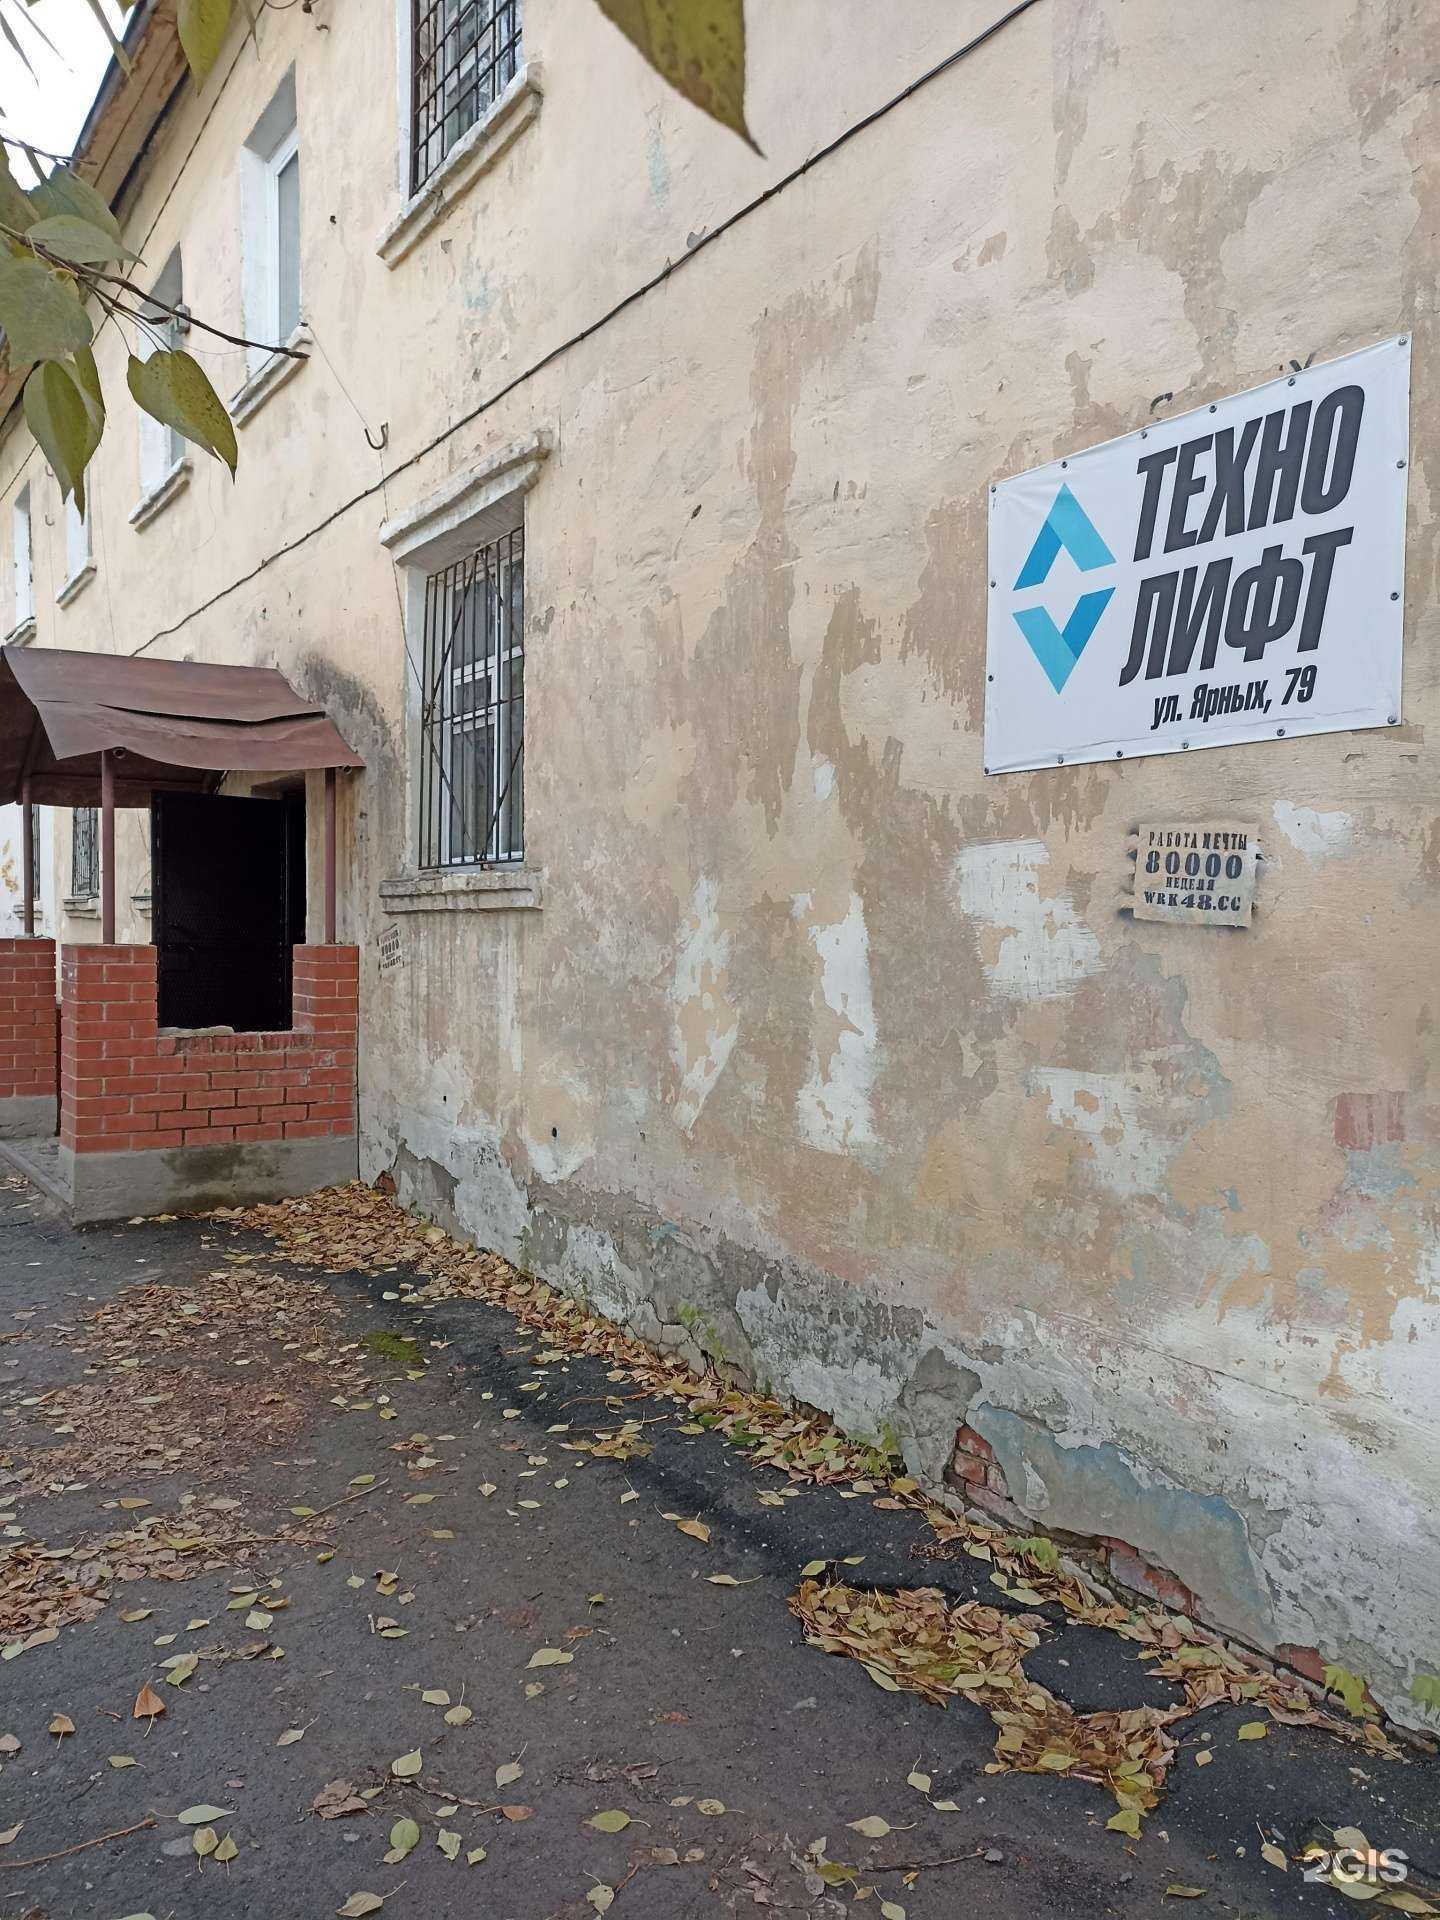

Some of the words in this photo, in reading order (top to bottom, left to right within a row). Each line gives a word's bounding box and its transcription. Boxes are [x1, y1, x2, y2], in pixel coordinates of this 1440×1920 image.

[1133, 384, 1365, 563] ТЕХНО
[1119, 526, 1354, 687] ЛИФТ
[1151, 695, 1182, 730] ул.
[1189, 680, 1272, 723] Ярных,
[1281, 664, 1317, 705] 79
[1146, 850, 1243, 879] 80000
[1149, 831, 1197, 849] РАБОТА
[1202, 832, 1247, 851] МЕЧТЫ
[1166, 876, 1216, 891] НЕДЕЛЯ
